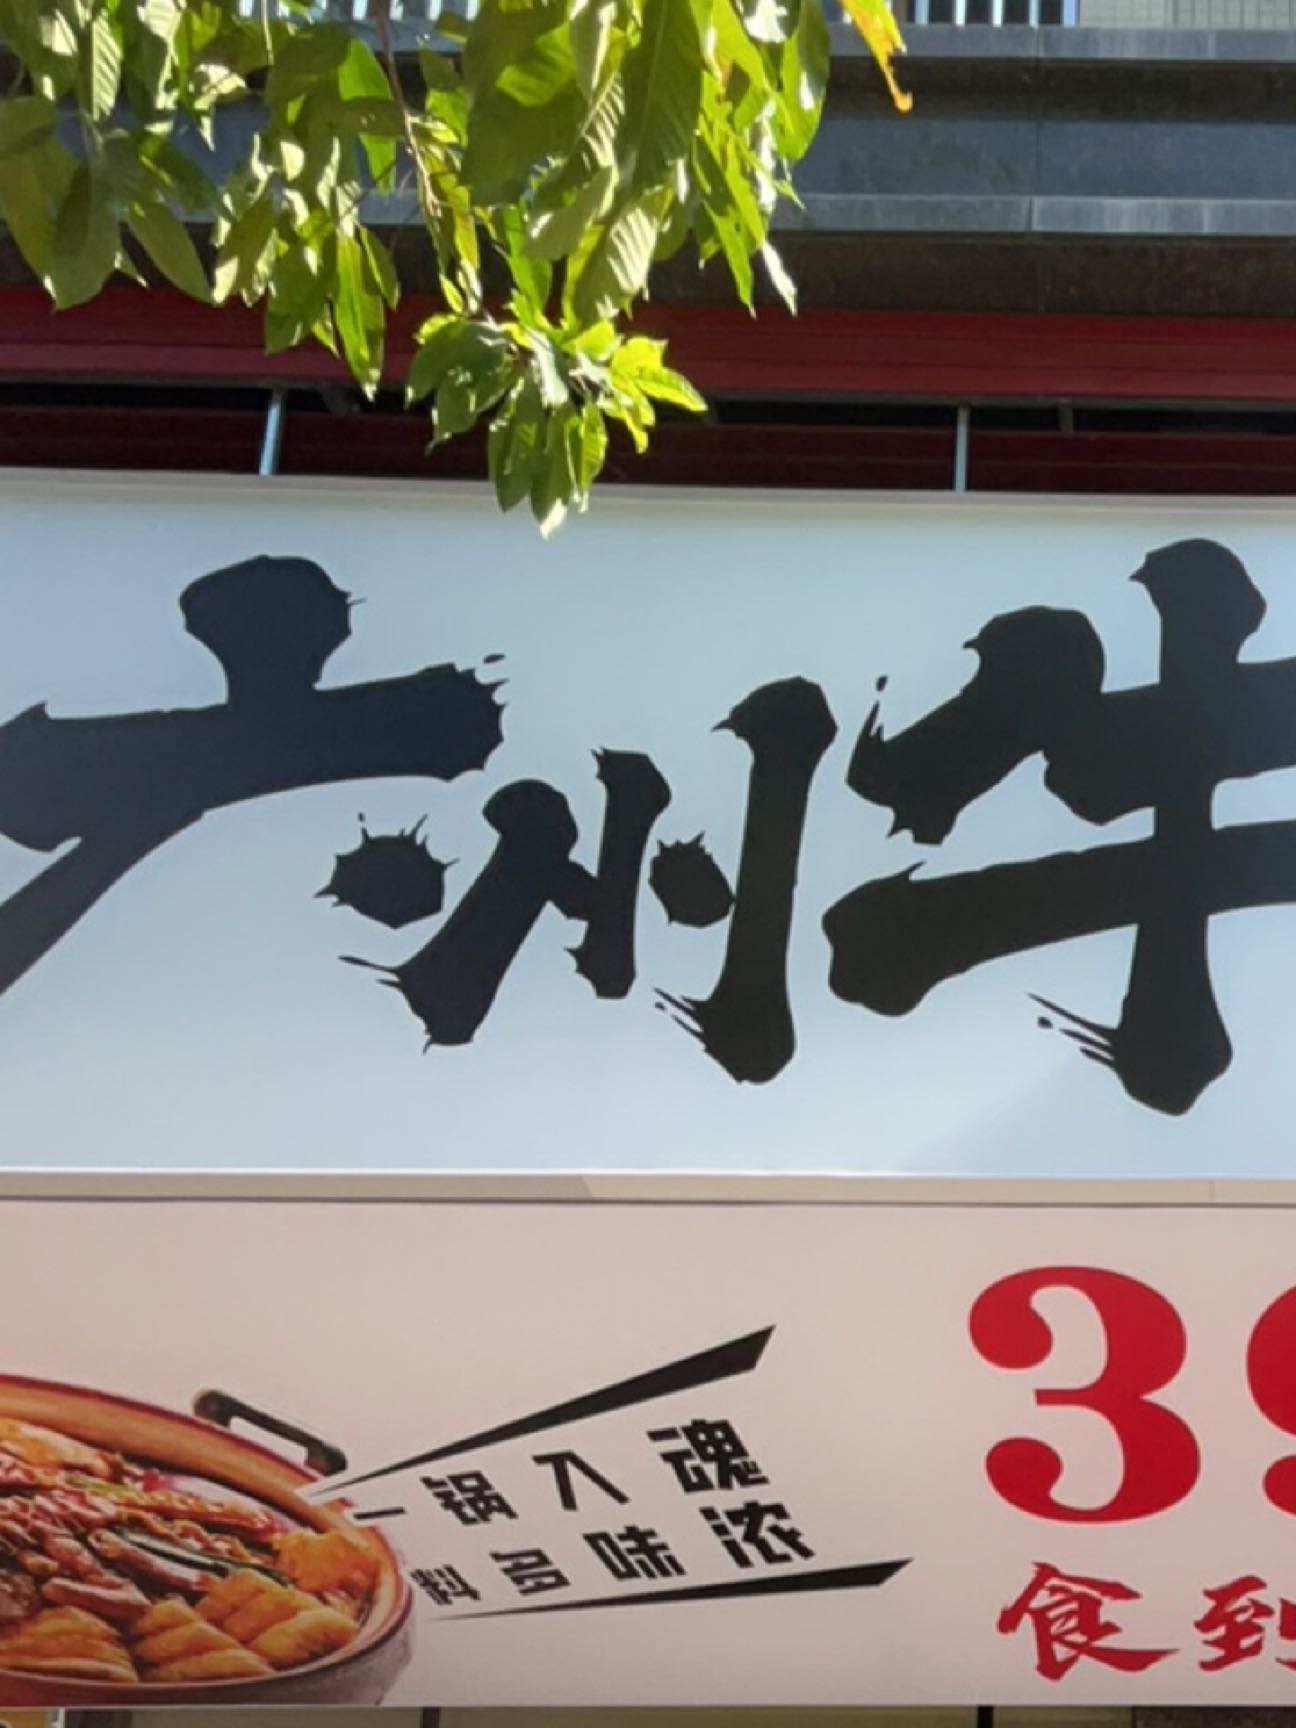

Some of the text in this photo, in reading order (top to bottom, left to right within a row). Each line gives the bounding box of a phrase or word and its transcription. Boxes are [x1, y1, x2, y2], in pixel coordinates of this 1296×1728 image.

[354, 1417, 772, 1528] 一锅入魂
[409, 1500, 815, 1607] 料多味浓
